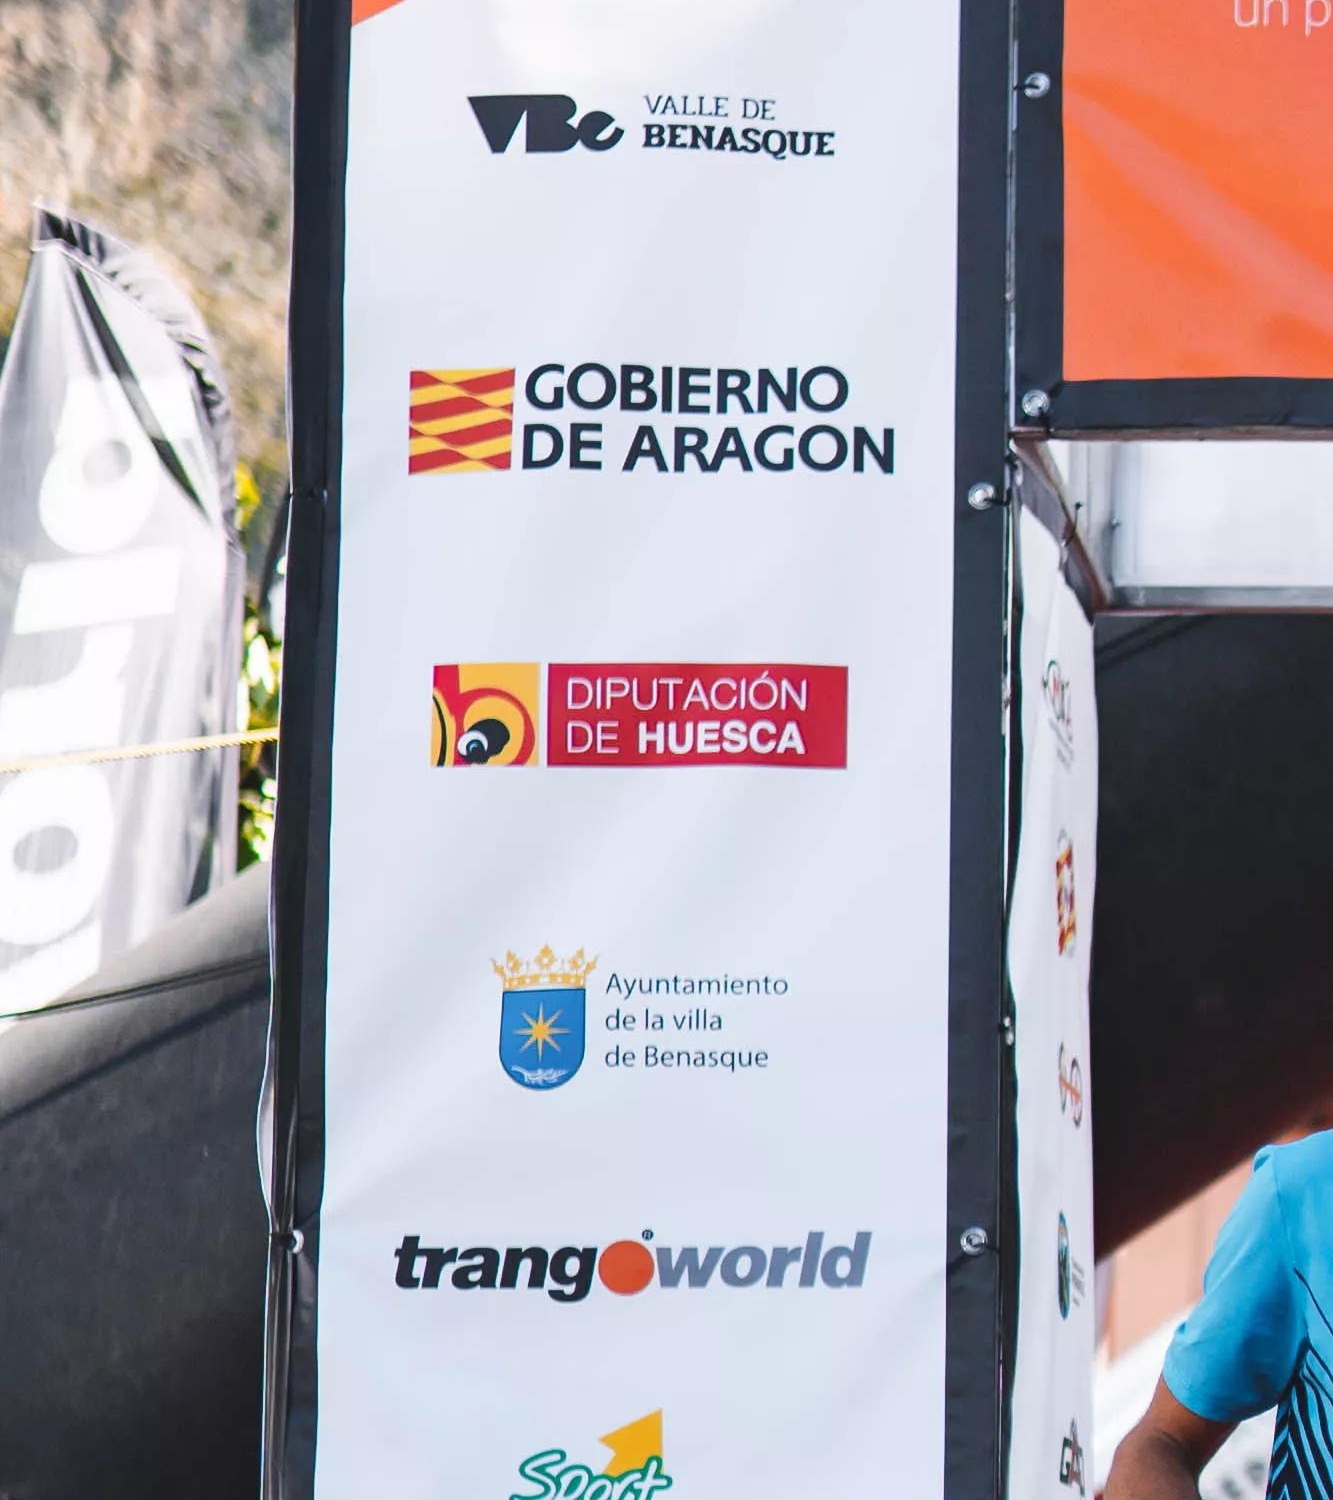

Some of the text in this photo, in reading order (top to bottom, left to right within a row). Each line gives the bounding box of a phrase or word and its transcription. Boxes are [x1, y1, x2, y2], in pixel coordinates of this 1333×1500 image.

[644, 94, 776, 121] VALLE DE
[642, 124, 836, 160] BENASQUE
[525, 362, 850, 415] GOBIERNO
[521, 423, 895, 475] DE ARAGON
[566, 671, 808, 713] DIPUTACIÓN
[566, 721, 806, 756] DE HUESCA
[604, 971, 790, 1001] Ayuntamiento
[604, 1007, 724, 1033] de la villa
[604, 1044, 769, 1075] de Benasque
